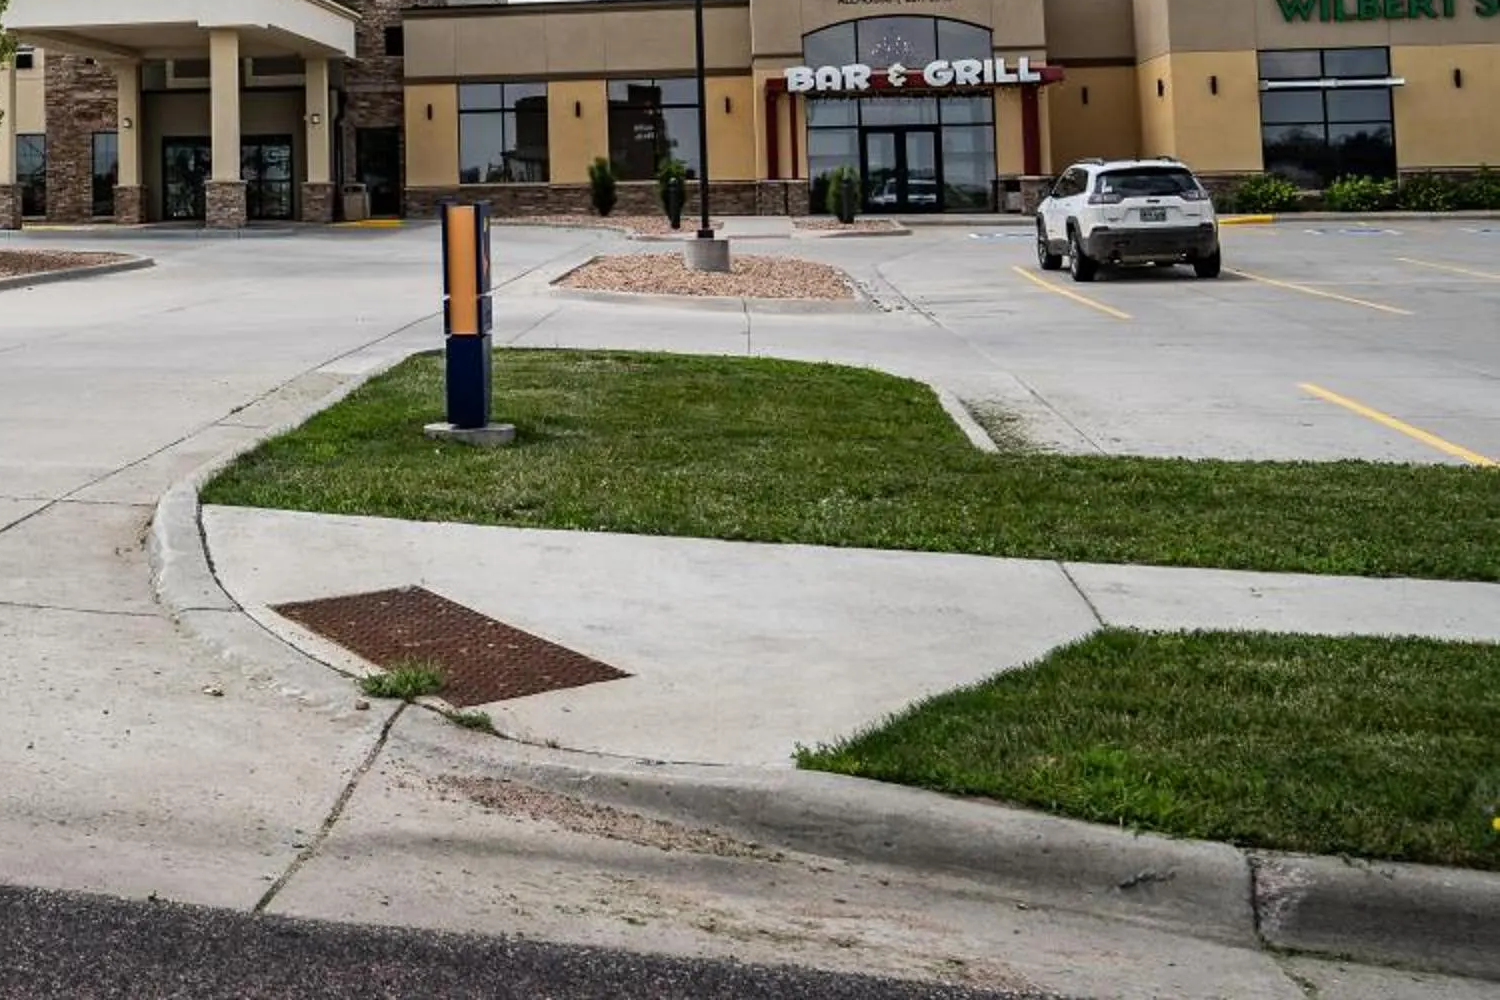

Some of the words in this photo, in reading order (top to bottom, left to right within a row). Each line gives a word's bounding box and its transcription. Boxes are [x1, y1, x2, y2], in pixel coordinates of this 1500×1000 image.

[784, 65, 872, 92] BAR
[887, 63, 907, 87] &
[923, 56, 1041, 87] GRILL
